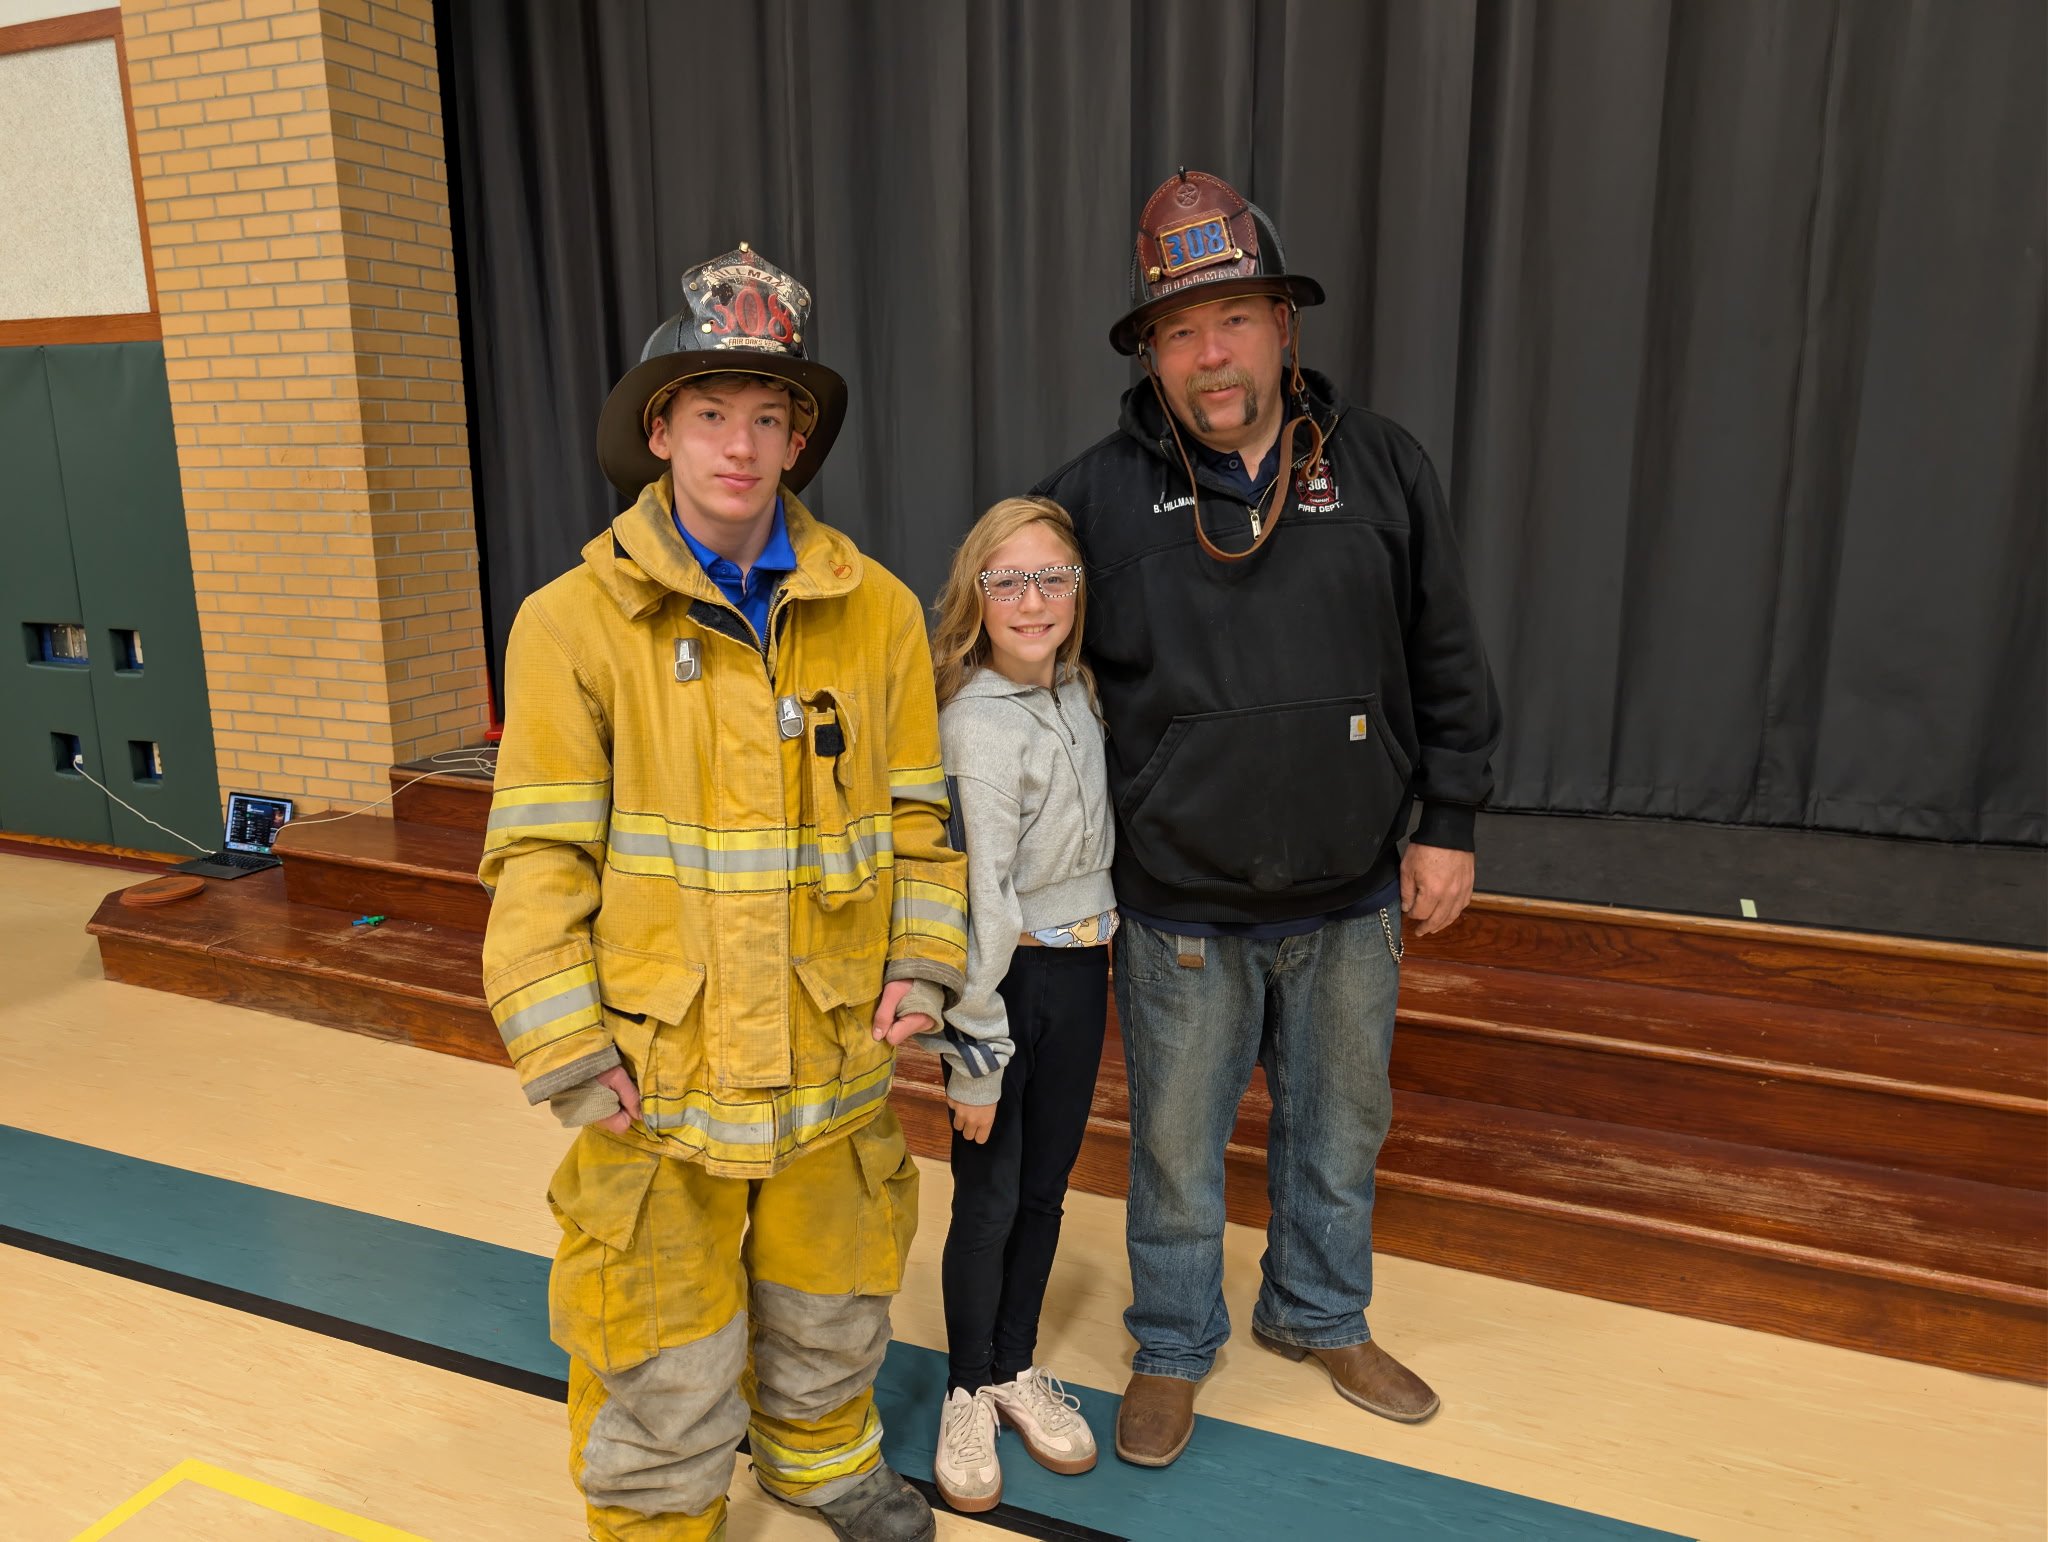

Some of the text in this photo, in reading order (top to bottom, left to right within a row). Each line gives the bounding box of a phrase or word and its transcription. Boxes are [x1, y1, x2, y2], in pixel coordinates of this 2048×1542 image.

[1165, 222, 1225, 266] 308
[1307, 478, 1328, 491] 308
[1153, 496, 1196, 513] B. HILLMAN
[1298, 501, 1344, 513] FIRE DEPT.
